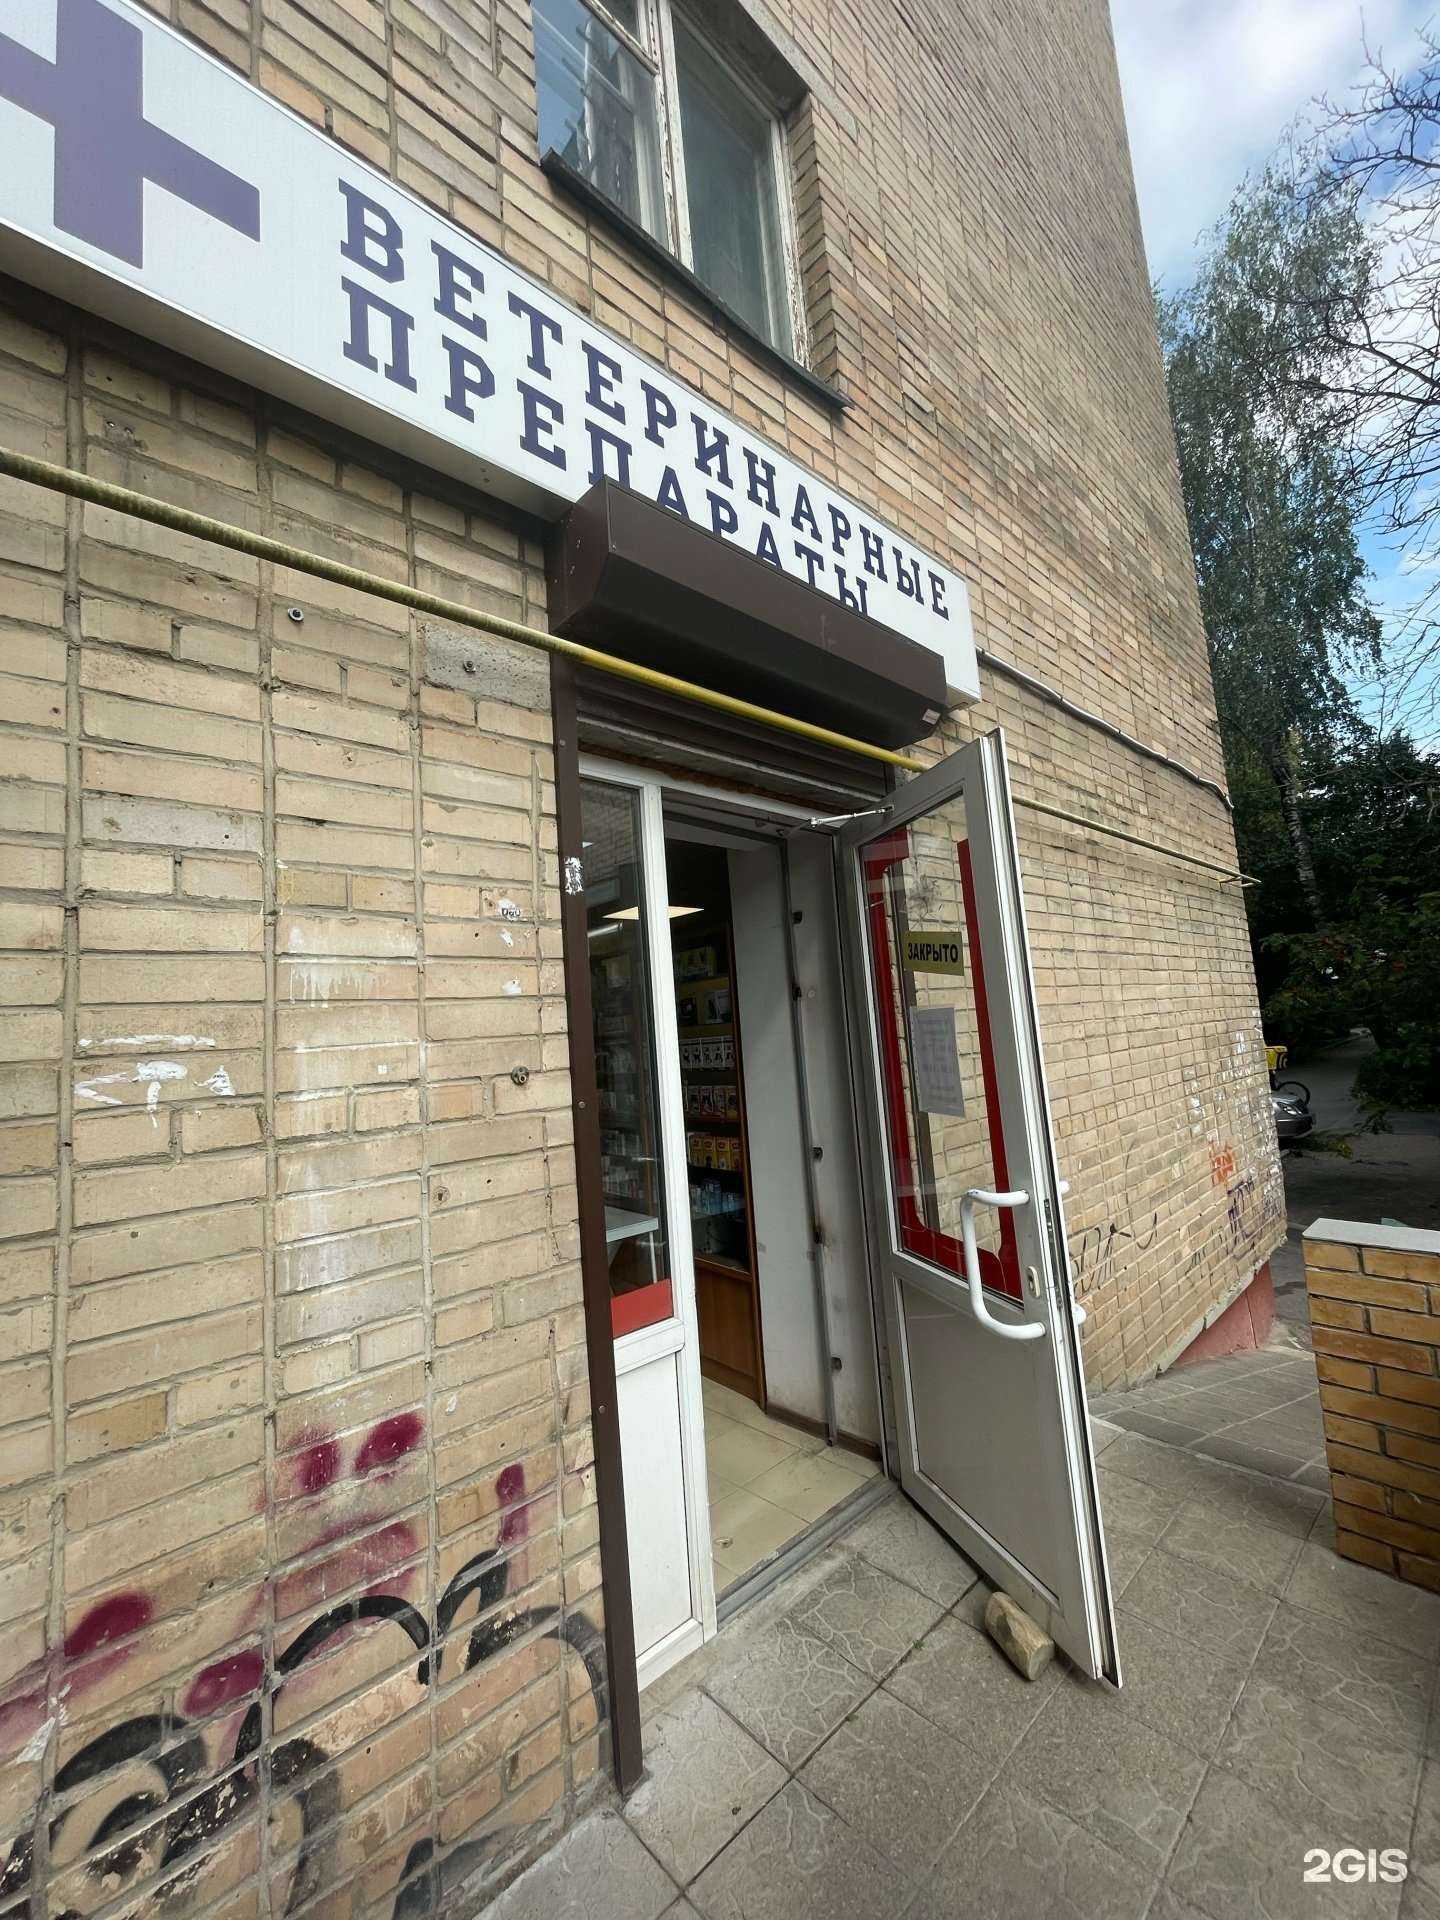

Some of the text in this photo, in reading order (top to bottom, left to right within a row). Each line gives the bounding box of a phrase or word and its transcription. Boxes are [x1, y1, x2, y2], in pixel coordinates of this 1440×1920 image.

[339, 178, 950, 622] ВЕТЕРИНАРНЫЕ
[341, 276, 869, 617] ПРЕПАРАТЫ
[907, 942, 959, 963] ЗАКРЫТО
